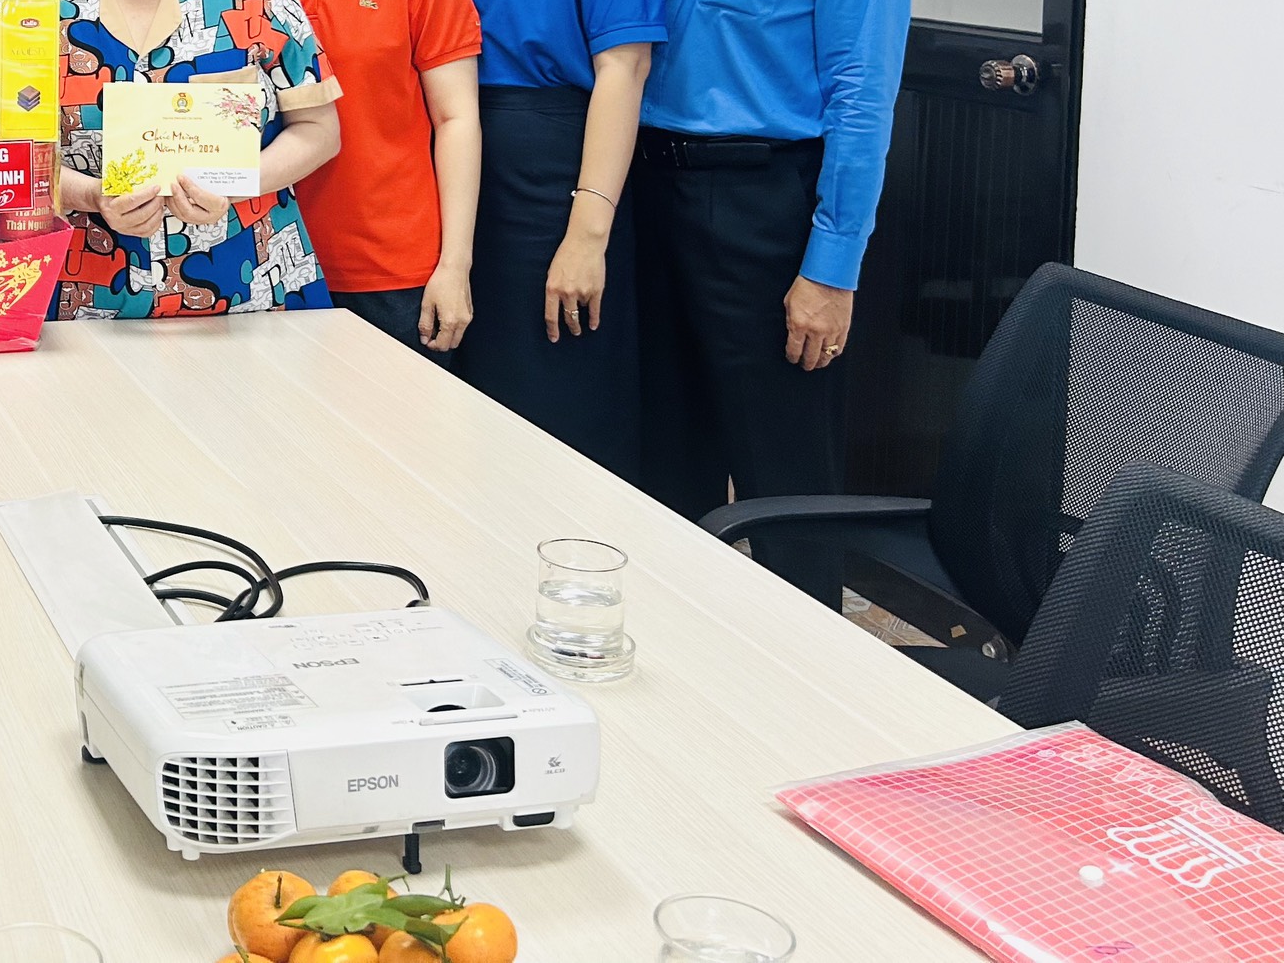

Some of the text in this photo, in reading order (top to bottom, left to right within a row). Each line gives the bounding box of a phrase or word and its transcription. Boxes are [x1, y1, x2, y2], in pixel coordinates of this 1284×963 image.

[142, 128, 200, 144] Chúc Mừng
[155, 143, 220, 154] Năm Mới 2024
[5, 219, 26, 231] Thái
[292, 657, 360, 669] EPSON
[347, 774, 399, 792] EPSON
